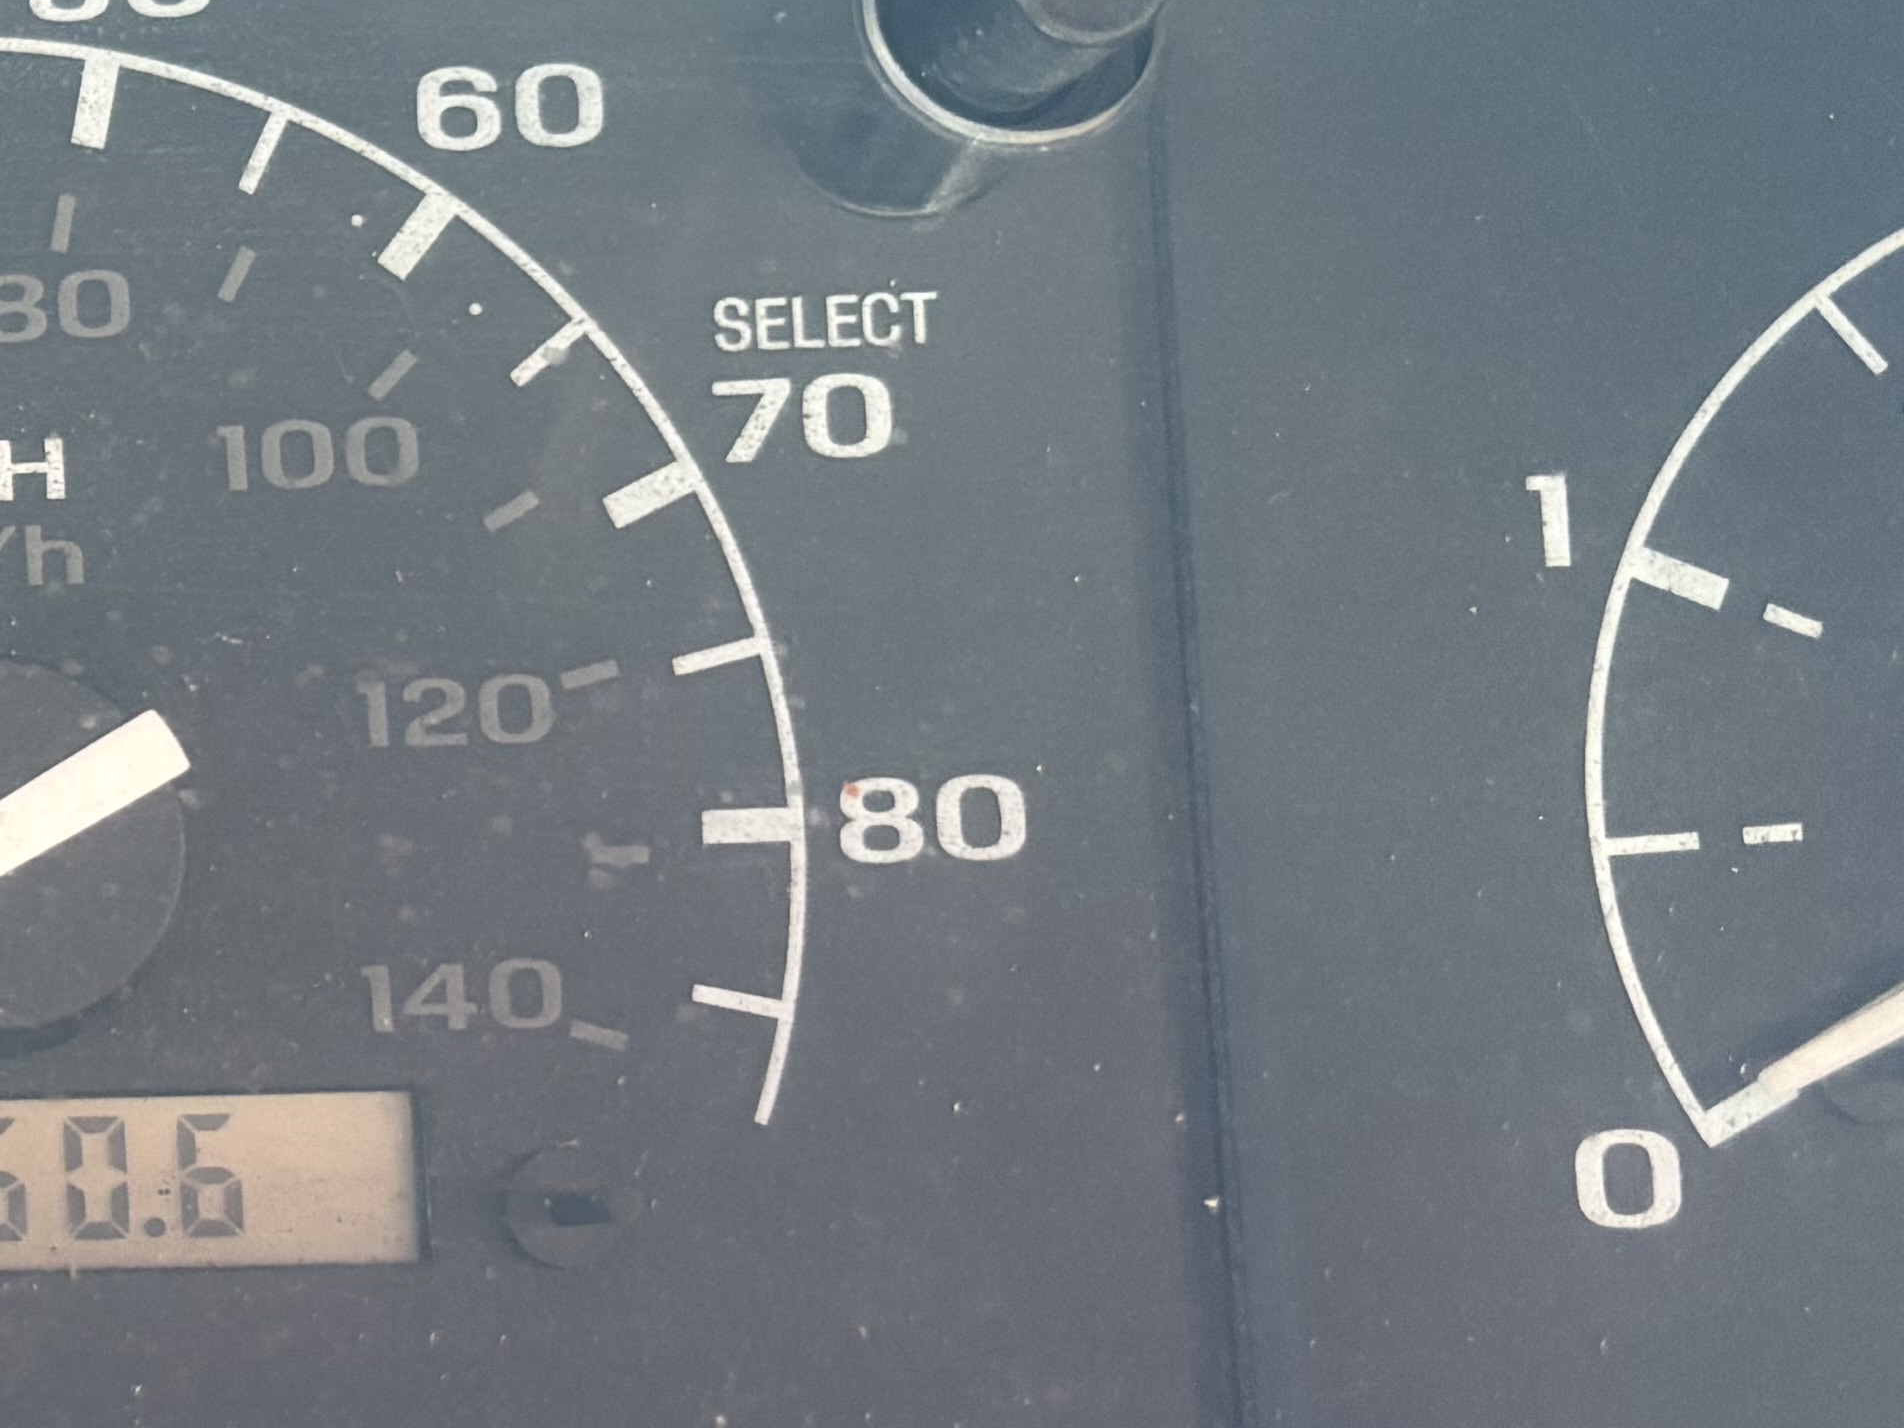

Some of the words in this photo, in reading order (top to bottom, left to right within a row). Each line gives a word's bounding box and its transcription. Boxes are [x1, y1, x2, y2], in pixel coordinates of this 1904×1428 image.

[416, 63, 605, 150] 60
[713, 290, 938, 351] SELECT
[216, 417, 420, 492] 100
[712, 374, 893, 461] 70
[1526, 475, 1571, 567] 1
[358, 672, 554, 748] 120
[839, 774, 1028, 863] 80
[361, 958, 564, 1032] 140
[1575, 1128, 1682, 1228] 0
